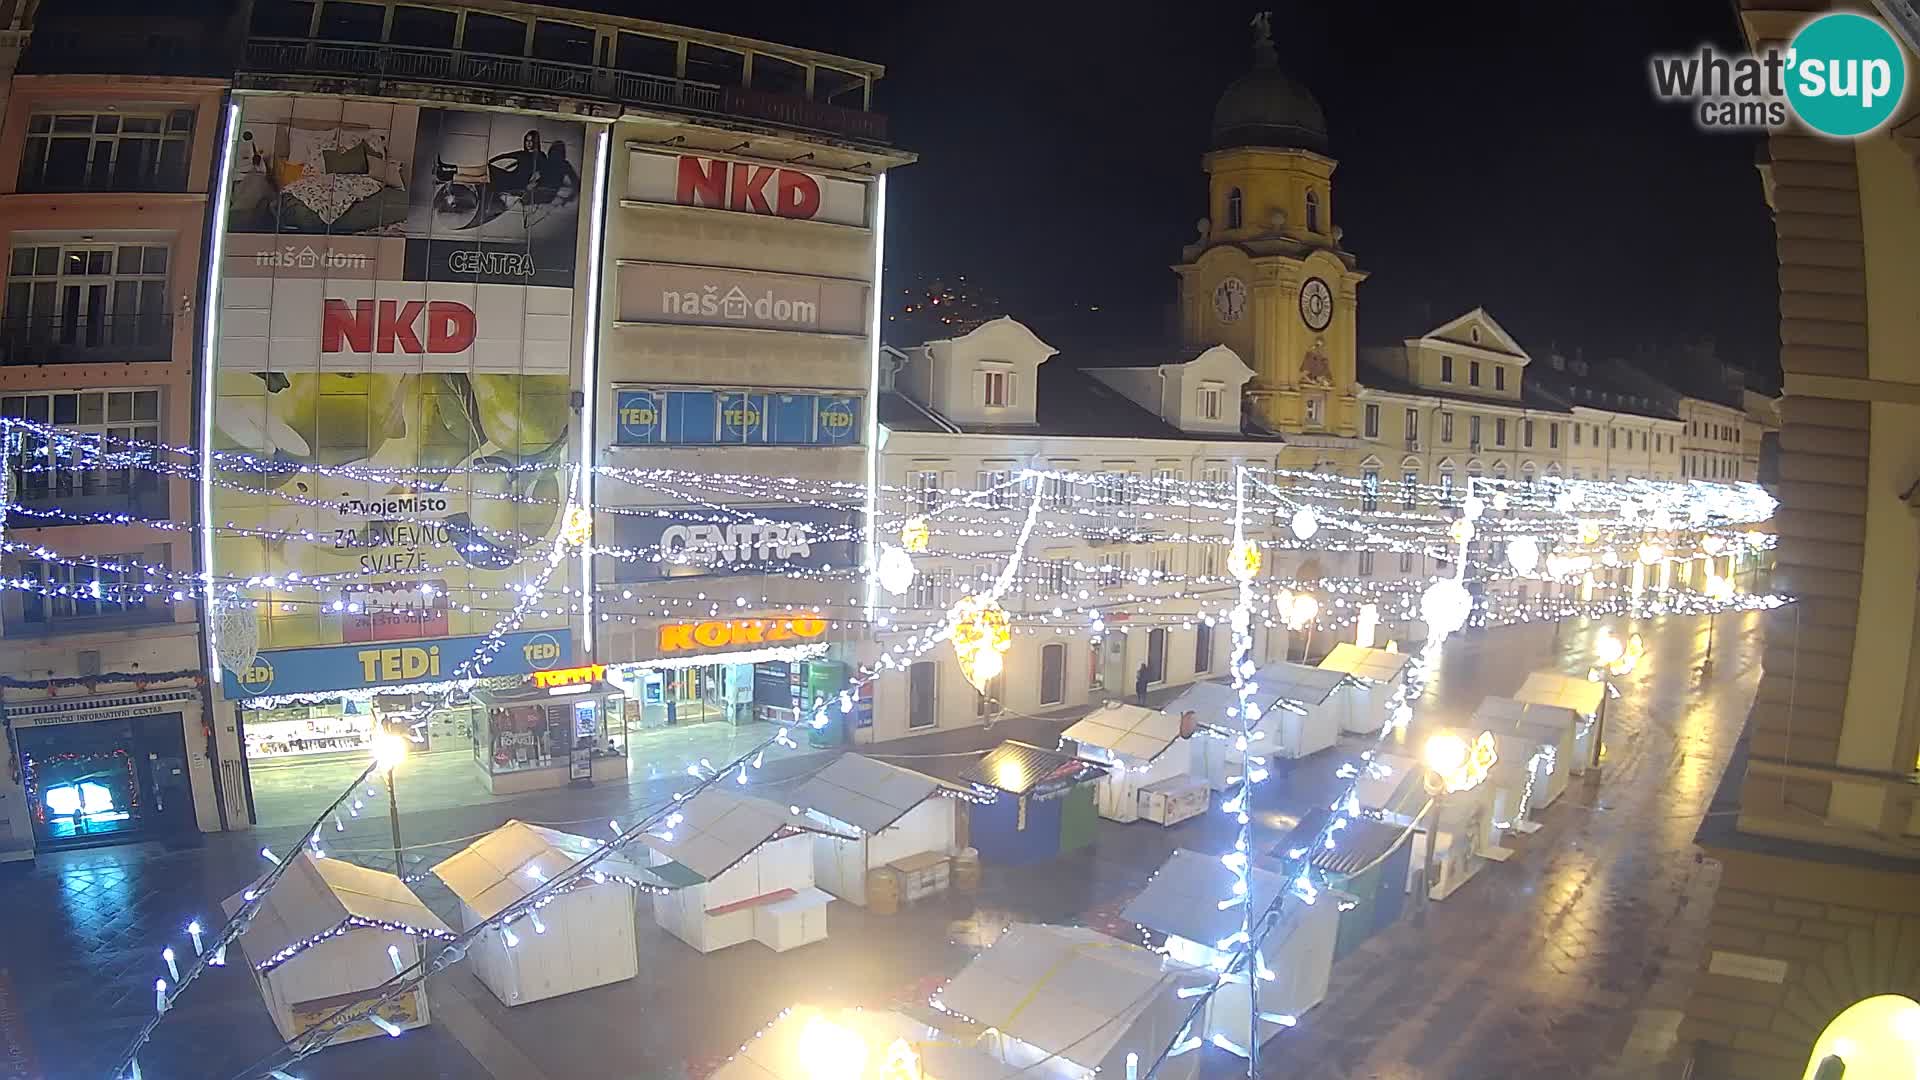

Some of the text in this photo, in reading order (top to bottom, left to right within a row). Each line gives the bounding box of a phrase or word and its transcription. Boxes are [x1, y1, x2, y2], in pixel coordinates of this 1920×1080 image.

[676, 154, 821, 219] NKD
[255, 246, 368, 269] naš dom
[448, 250, 536, 277] CENTRA
[662, 284, 817, 323] naš dom
[321, 298, 478, 354] NKD
[619, 408, 658, 425] TEDi
[723, 409, 760, 426] TEDi
[820, 411, 854, 427] TEDi
[339, 497, 447, 516] #TvojeMisto
[334, 523, 451, 548] ZA DNEVNO
[659, 522, 810, 565] CENTRA
[360, 547, 427, 575] SVJEŽE
[659, 614, 828, 651] KORZO
[358, 645, 440, 681] TEDi
[523, 643, 560, 660] TEDi
[533, 663, 607, 689] TOMMY
[76, 709, 130, 721] INFORMATIVNI
[133, 706, 163, 716] CENTAR
